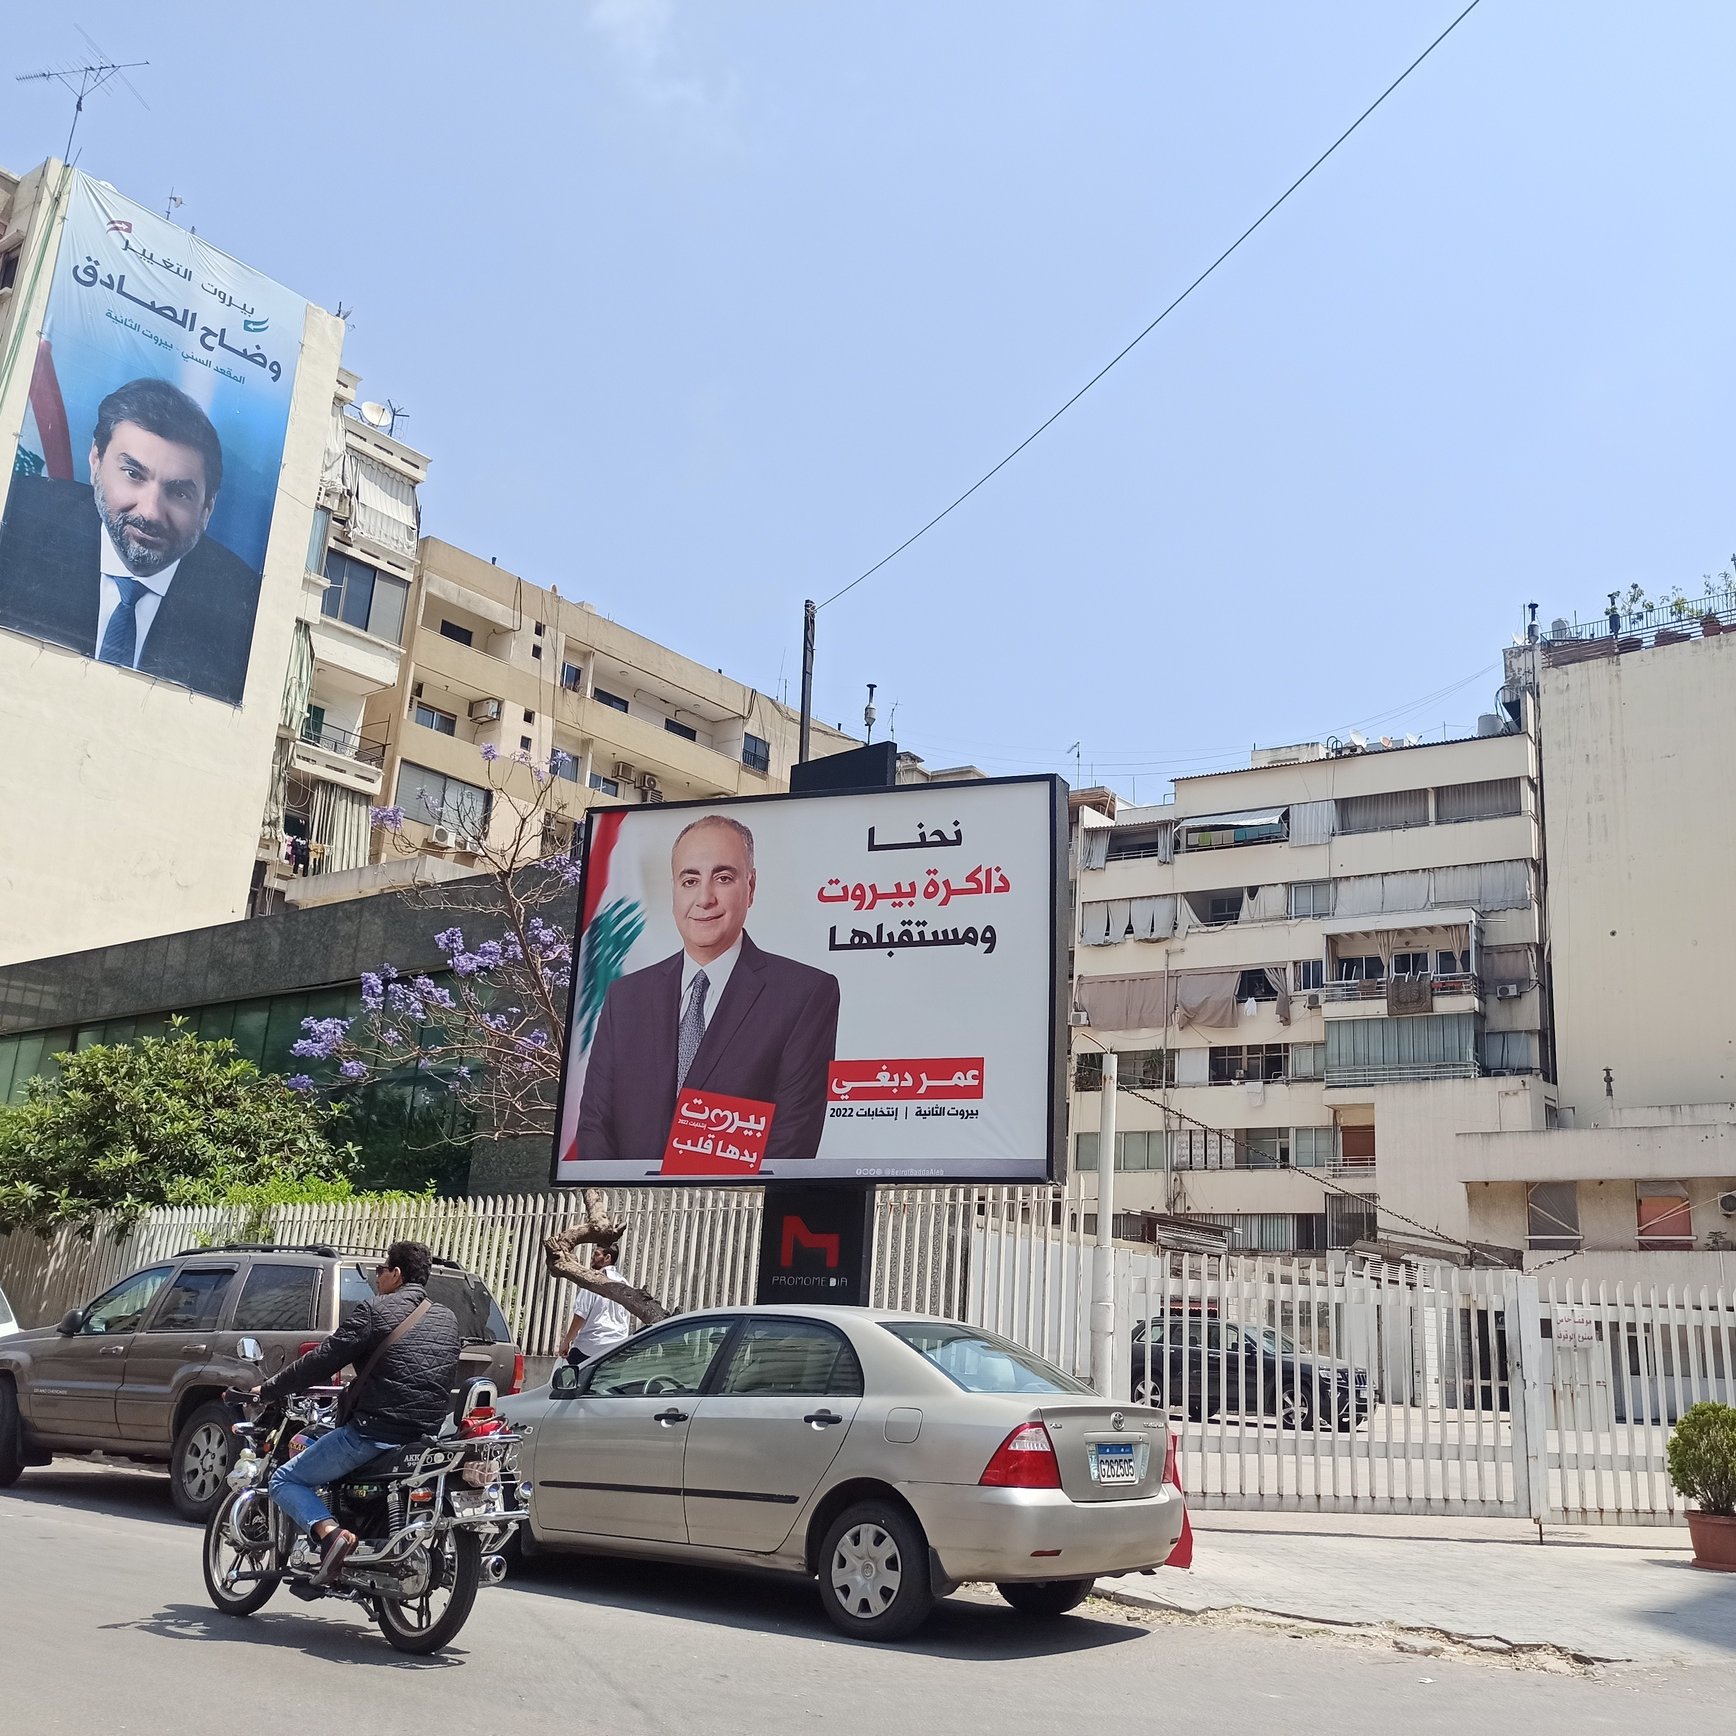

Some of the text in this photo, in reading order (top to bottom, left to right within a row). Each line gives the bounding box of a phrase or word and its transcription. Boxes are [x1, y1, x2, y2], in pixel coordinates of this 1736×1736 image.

[122, 239, 255, 318] بيروت التغيير
[72, 256, 282, 383] وضاح الصادق
[105, 308, 141, 333] الثانية
[141, 327, 174, 351] بيروت
[181, 350, 212, 369] السني
[213, 363, 246, 385] المقعد
[867, 819, 963, 852] نحنا
[816, 864, 1012, 911] ذاكرة بيروت
[828, 919, 997, 958] ومستقبلها
[830, 1064, 980, 1100] عمر دبغي
[829, 1107, 854, 1119] 2022
[856, 1106, 898, 1121] إنتخابات
[914, 1105, 946, 1119] الثانية
[947, 1106, 979, 1119] بيروت
[672, 1133, 759, 1168] بدها قلب
[771, 1275, 848, 1287] PROMOMEDIA
[1099, 1459, 1135, 1478] G262505
